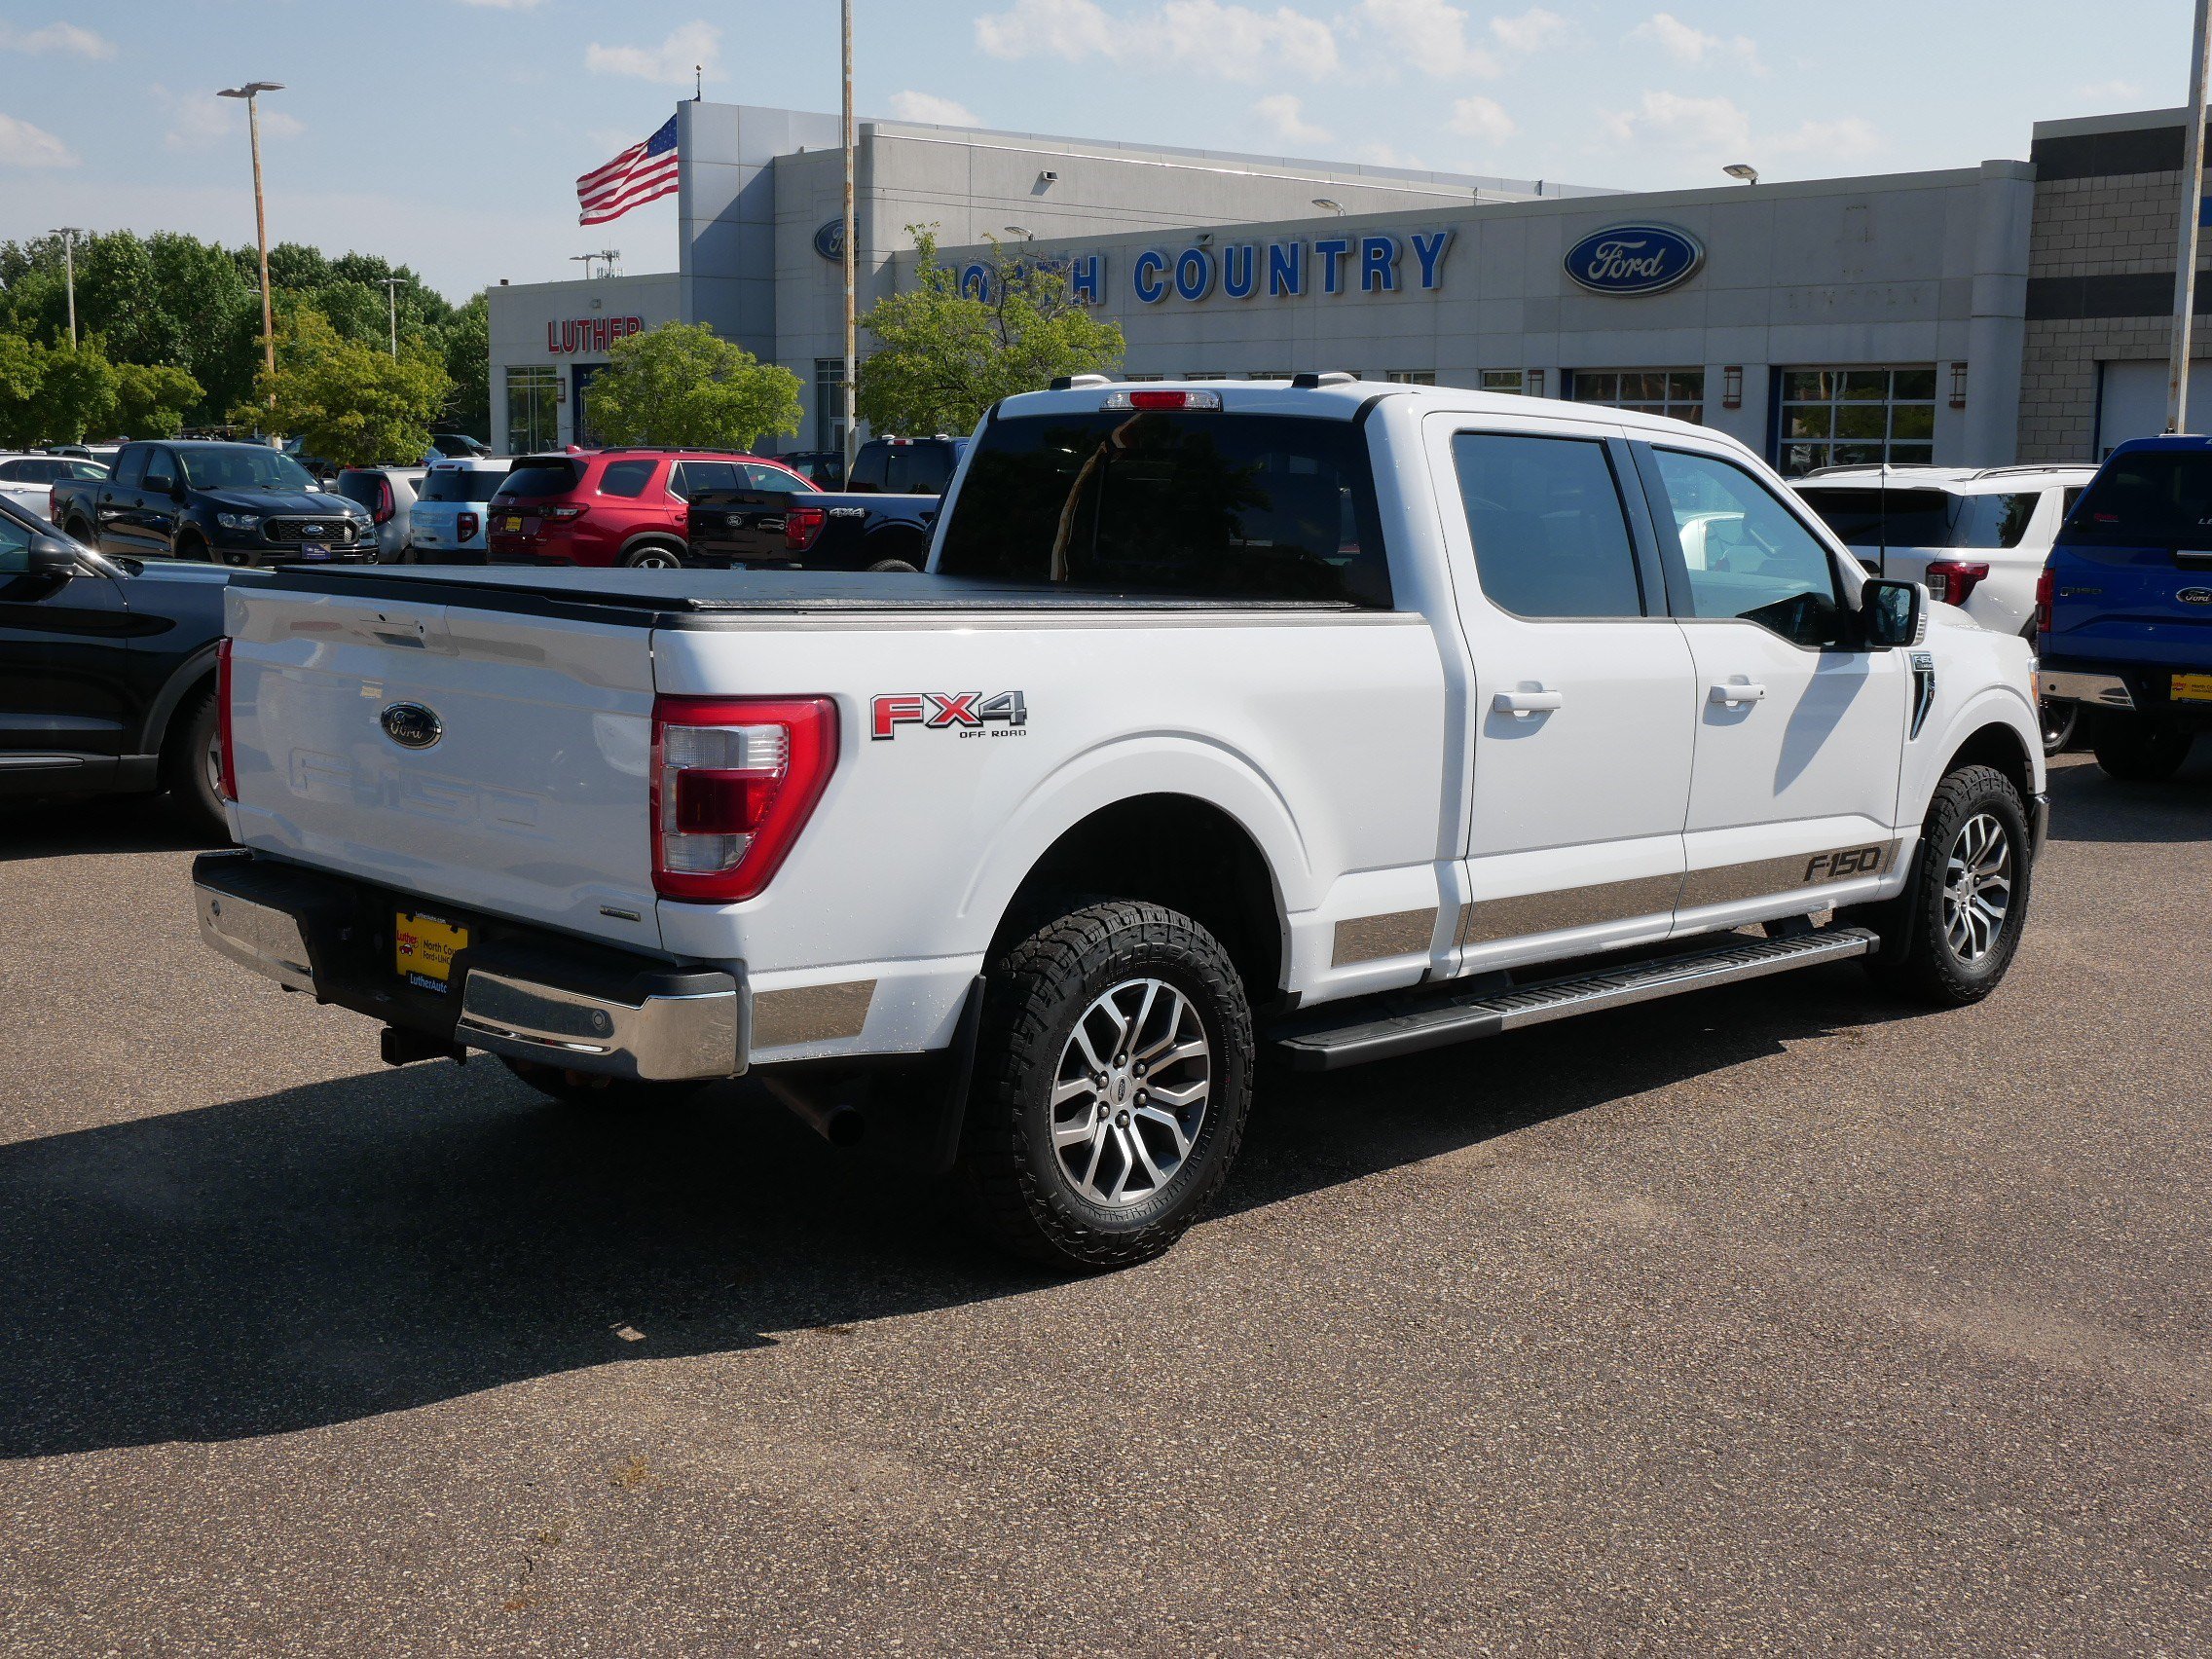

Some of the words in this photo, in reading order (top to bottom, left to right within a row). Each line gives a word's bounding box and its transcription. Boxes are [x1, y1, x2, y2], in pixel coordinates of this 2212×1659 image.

[1132, 231, 1449, 305] COUNTRY
[1587, 240, 1667, 280] Ford
[870, 690, 1027, 741] FX4
[959, 730, 986, 739] OFF
[991, 729, 1027, 738] ROAD
[1802, 846, 1882, 882] F-150
[397, 930, 419, 944] Luther
[424, 940, 442, 953] North
